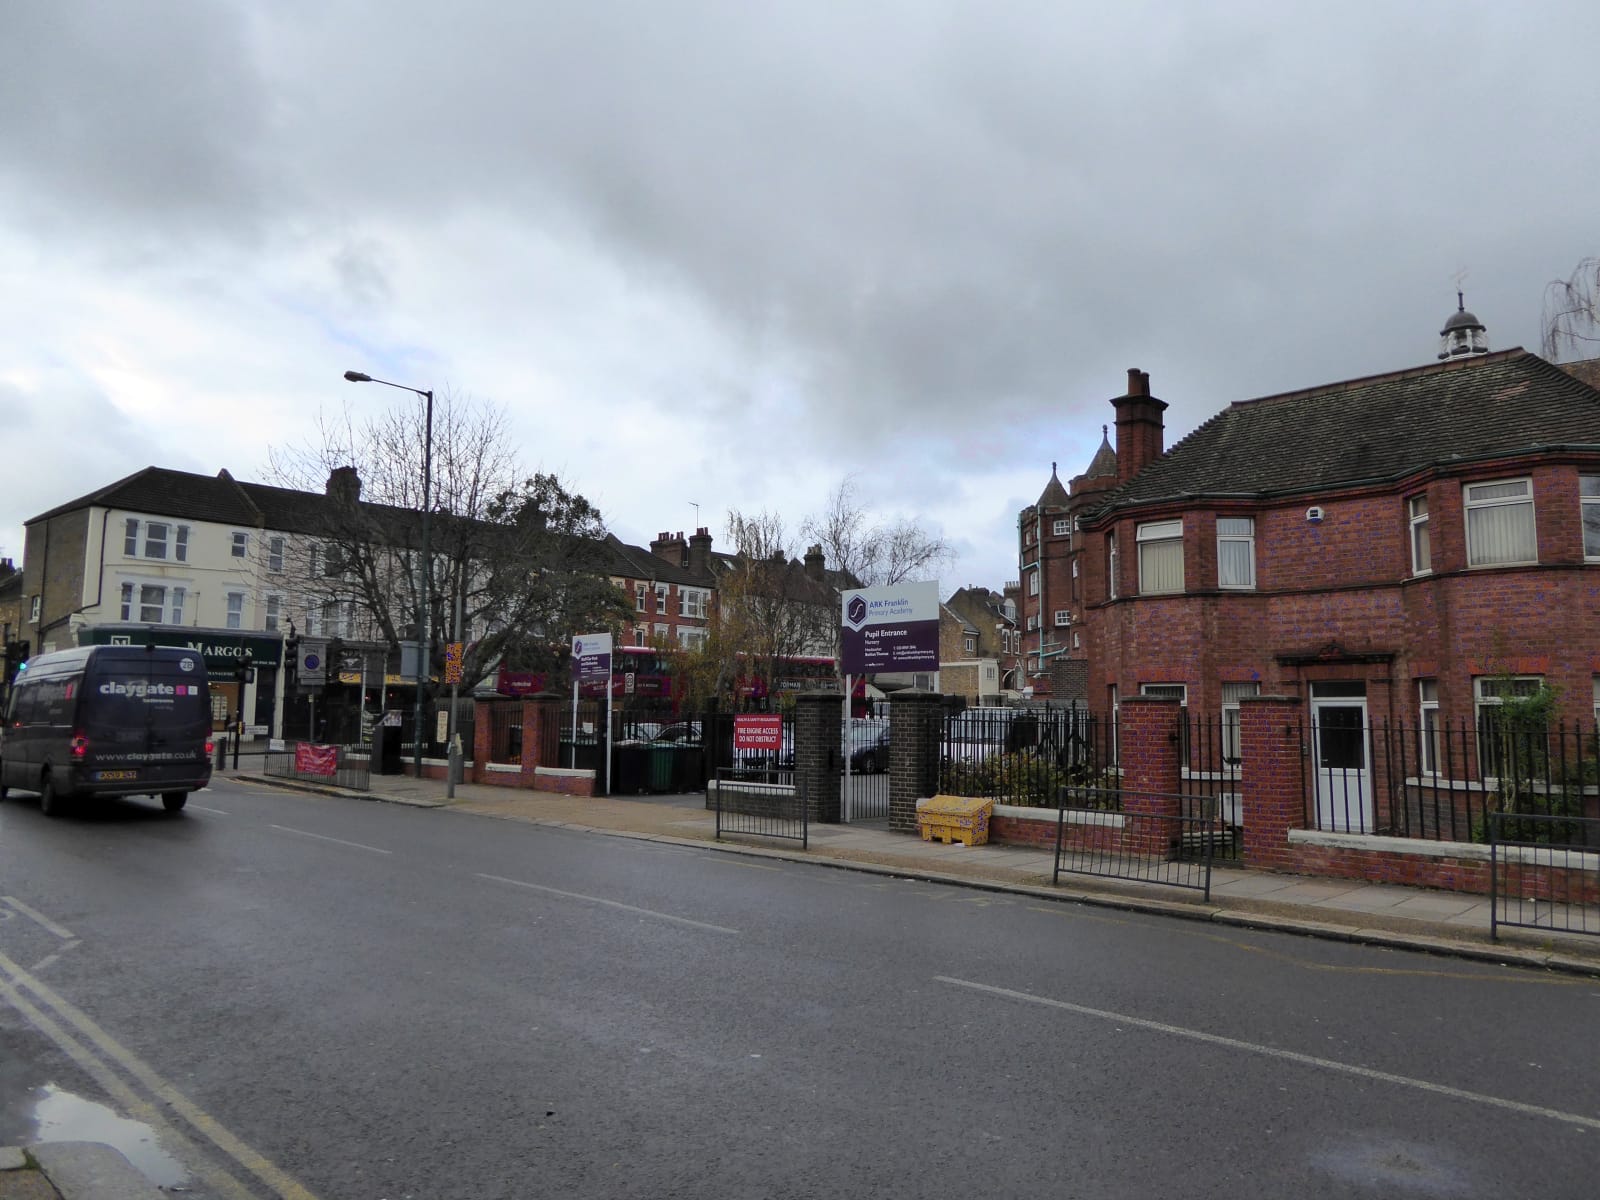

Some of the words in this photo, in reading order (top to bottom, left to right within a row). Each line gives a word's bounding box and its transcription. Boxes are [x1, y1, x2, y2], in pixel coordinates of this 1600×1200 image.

[884, 599, 908, 607] Franklin
[865, 630, 880, 639] Pupil
[880, 629, 908, 637] Entrance
[99, 681, 174, 697] claygate
[746, 727, 762, 735] ENGINE
[762, 727, 779, 735] ACCESS
[755, 735, 777, 743] OBSTRUCT
[95, 751, 197, 761] www.claygate.co.uk
